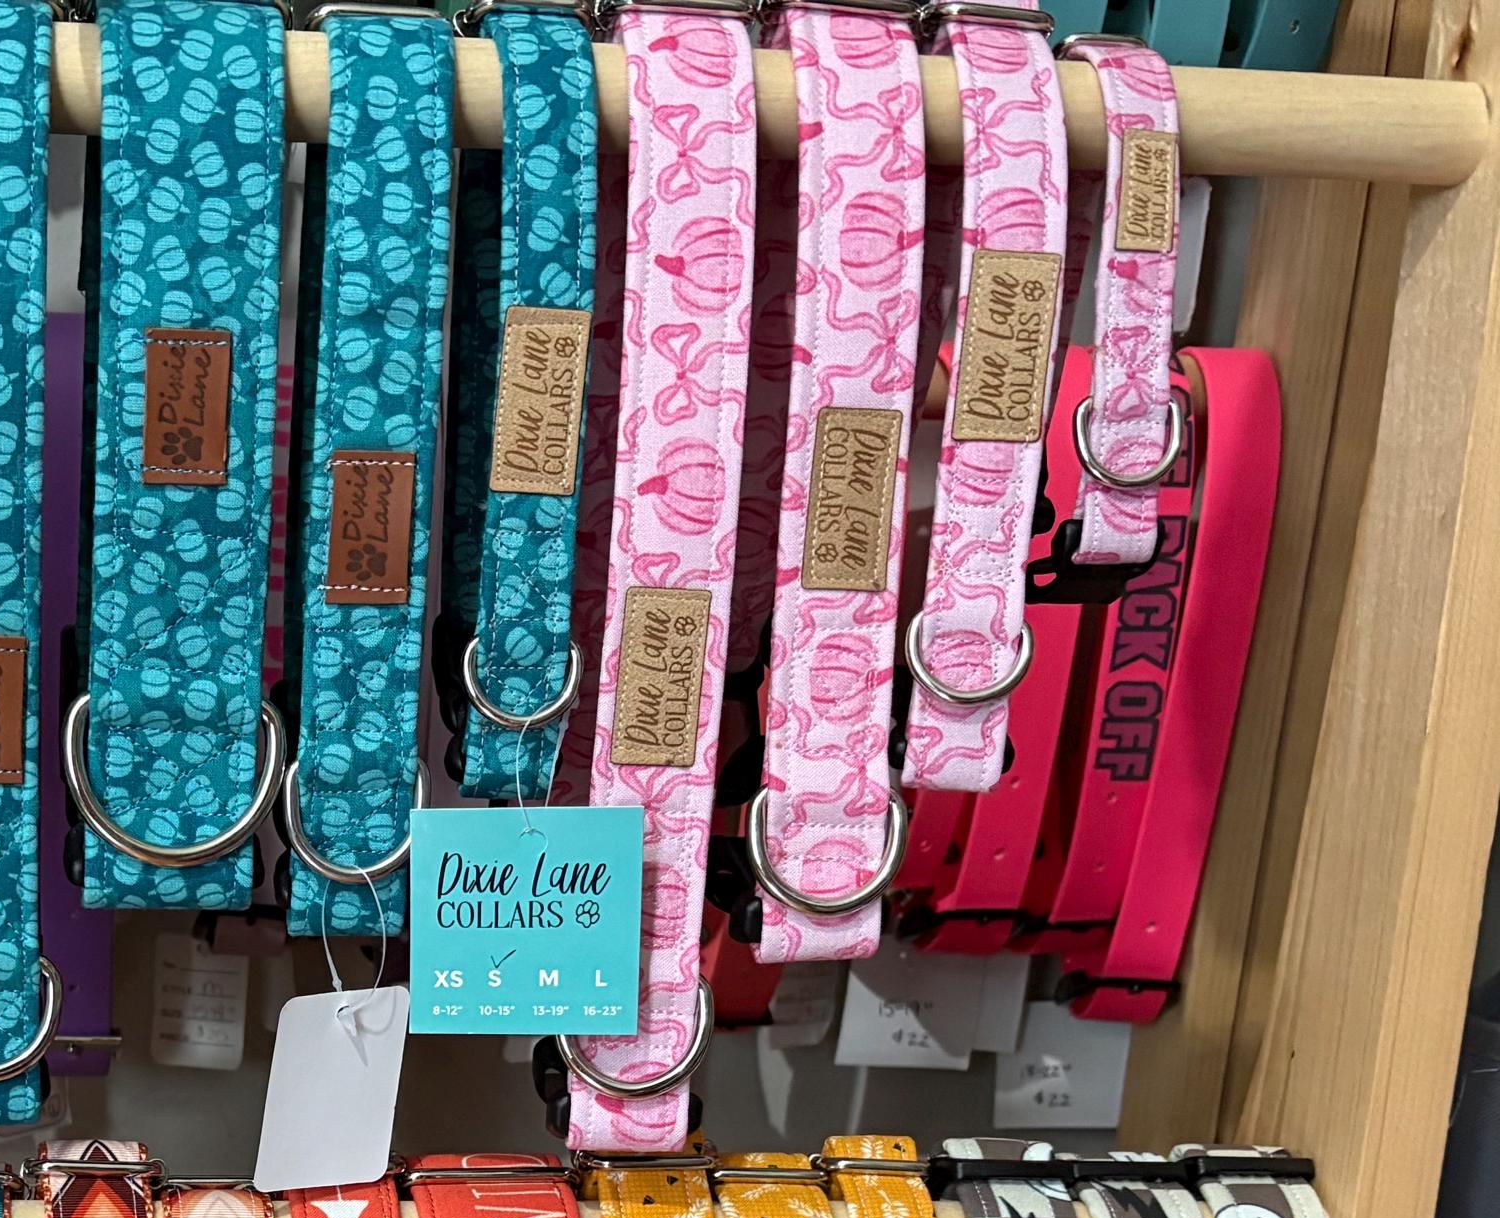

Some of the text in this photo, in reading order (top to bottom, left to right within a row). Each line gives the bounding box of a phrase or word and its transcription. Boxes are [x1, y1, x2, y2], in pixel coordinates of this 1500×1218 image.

[1126, 143, 1153, 240] Dixie Lane
[1150, 167, 1170, 241] COLLARS
[158, 343, 188, 425] Dixie
[184, 347, 213, 427] Lane
[965, 271, 1021, 421] Dixie Lane
[1007, 311, 1041, 423] COLLARS
[502, 326, 552, 475] Dixie Lane
[540, 367, 575, 477] COLLARS
[343, 464, 370, 542] Dixie
[367, 466, 397, 543] Lane
[817, 426, 841, 534] COLLARS
[840, 428, 890, 571] Dixie Lane
[623, 608, 673, 748] Dixie Lane
[662, 645, 694, 748] COLLARS
[1094, 680, 1164, 782] OFF
[437, 852, 611, 899] Dixie Lane
[437, 901, 564, 928] COLLARS
[434, 969, 607, 988] XS S M L
